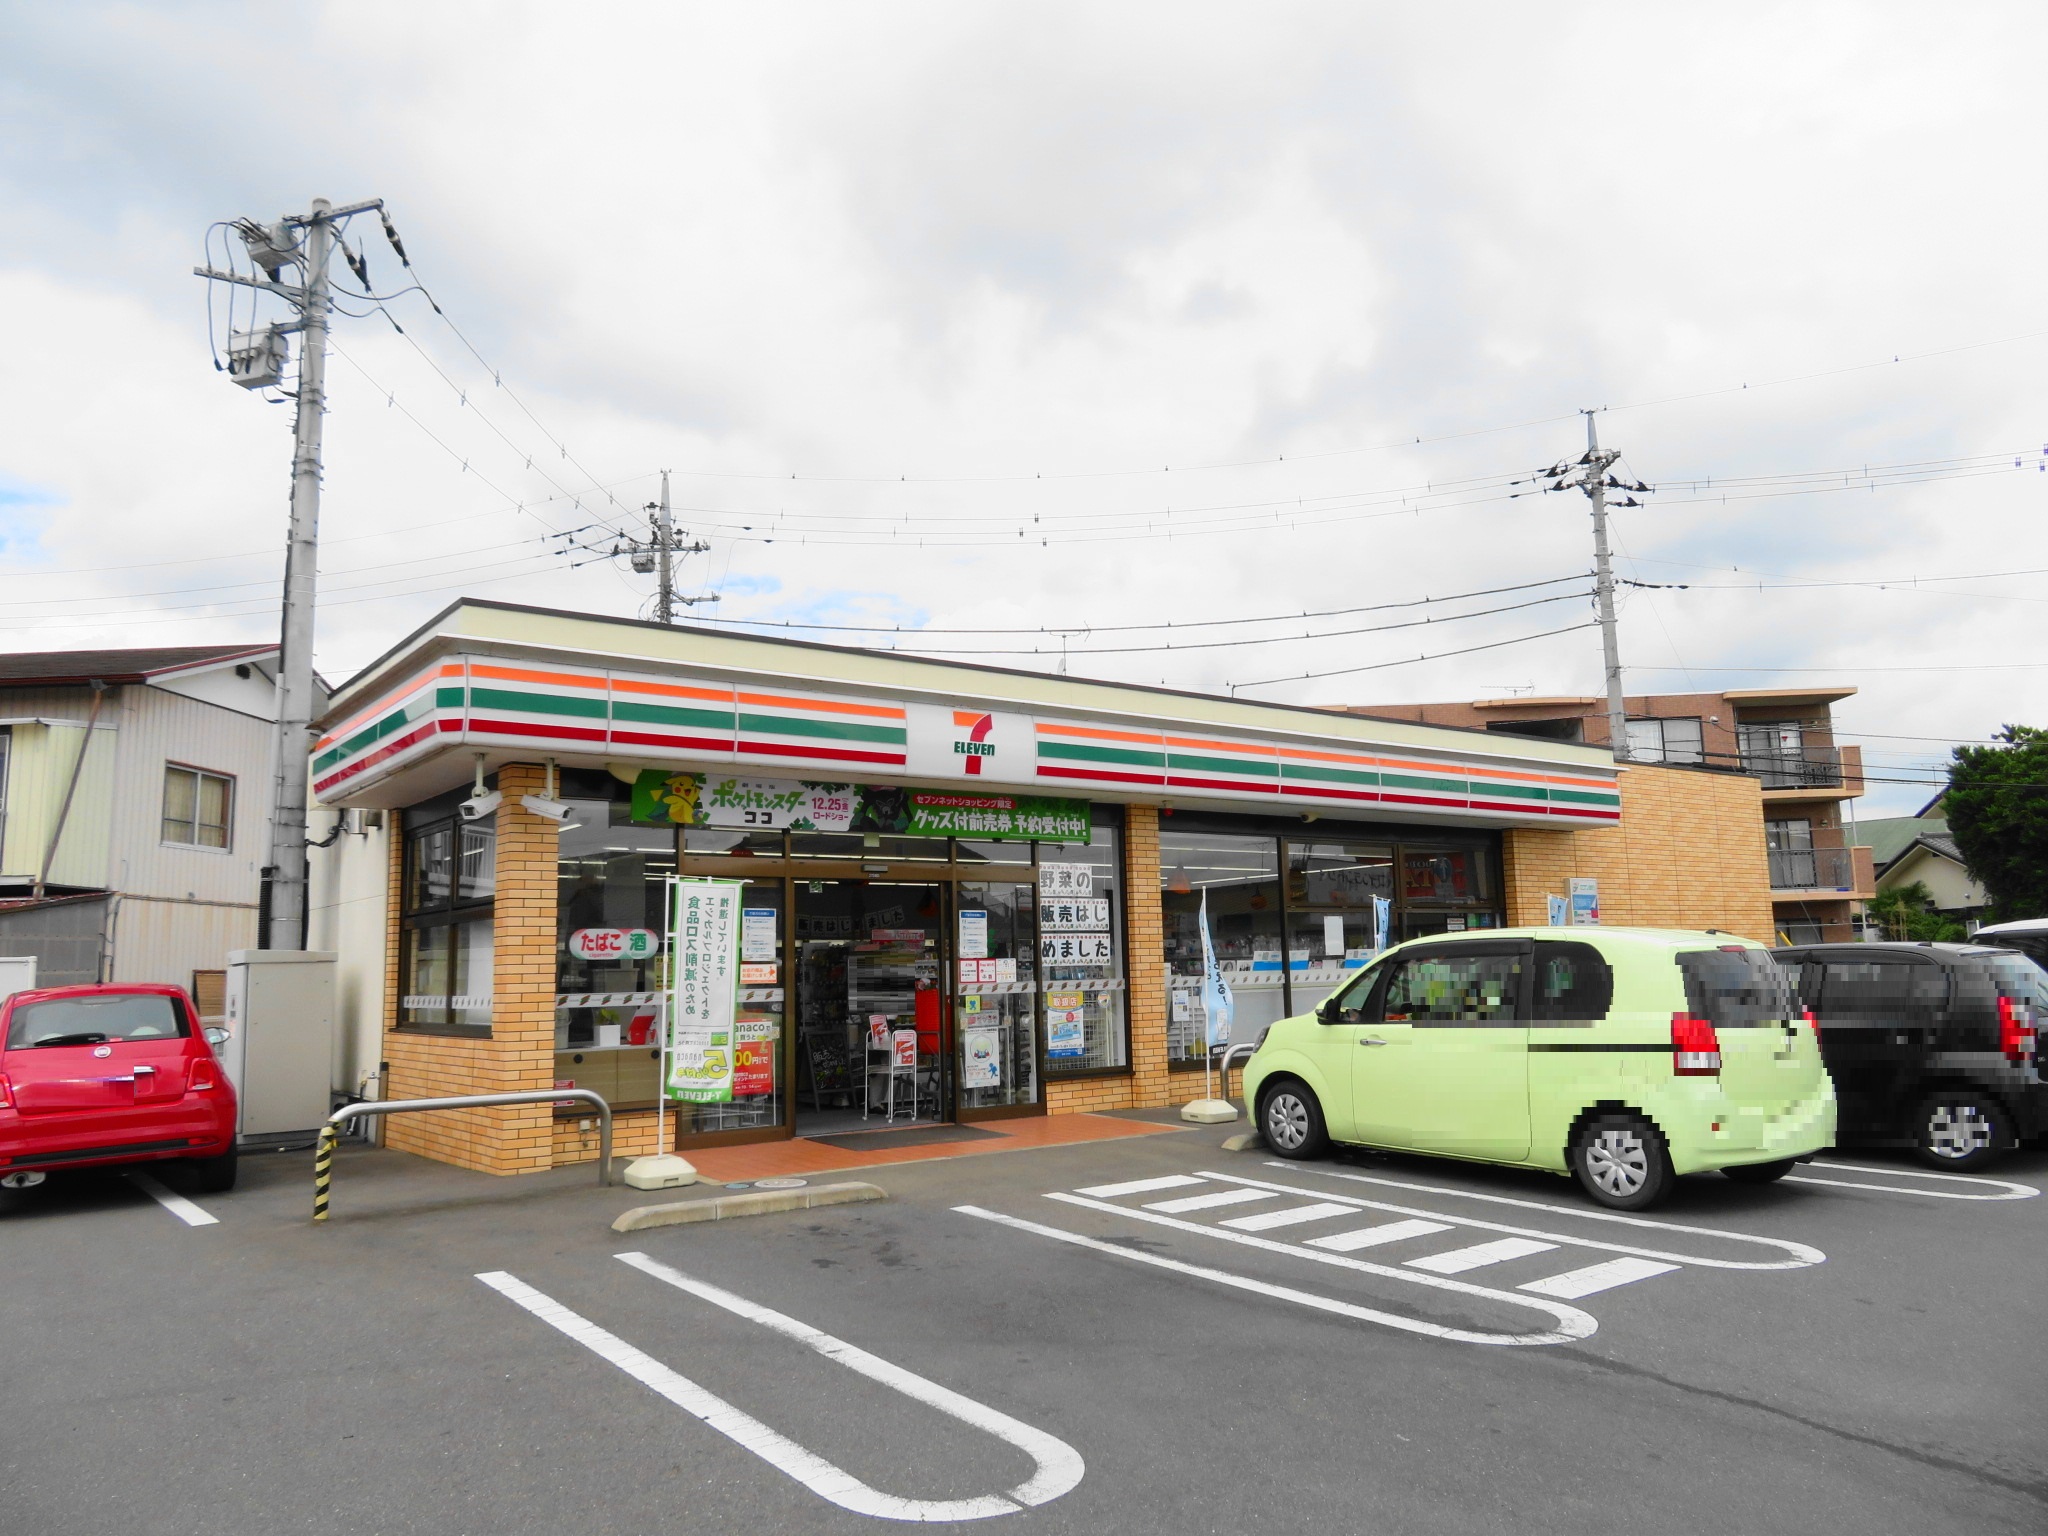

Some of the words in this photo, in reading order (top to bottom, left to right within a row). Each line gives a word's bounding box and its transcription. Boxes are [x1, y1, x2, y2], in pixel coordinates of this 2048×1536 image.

[709, 779, 807, 813] ポケットモンスター
[916, 795, 1012, 809] セブンネットショッピング限定
[744, 811, 773, 825] ココ
[813, 811, 849, 821] ロードショー
[914, 809, 1012, 833] グッズ付前売券
[1040, 870, 1090, 889] 野菜の
[1040, 904, 1107, 923] 販売はじ
[581, 932, 622, 951] たばこ
[629, 932, 647, 951] 酒
[1041, 940, 1109, 958] めました
